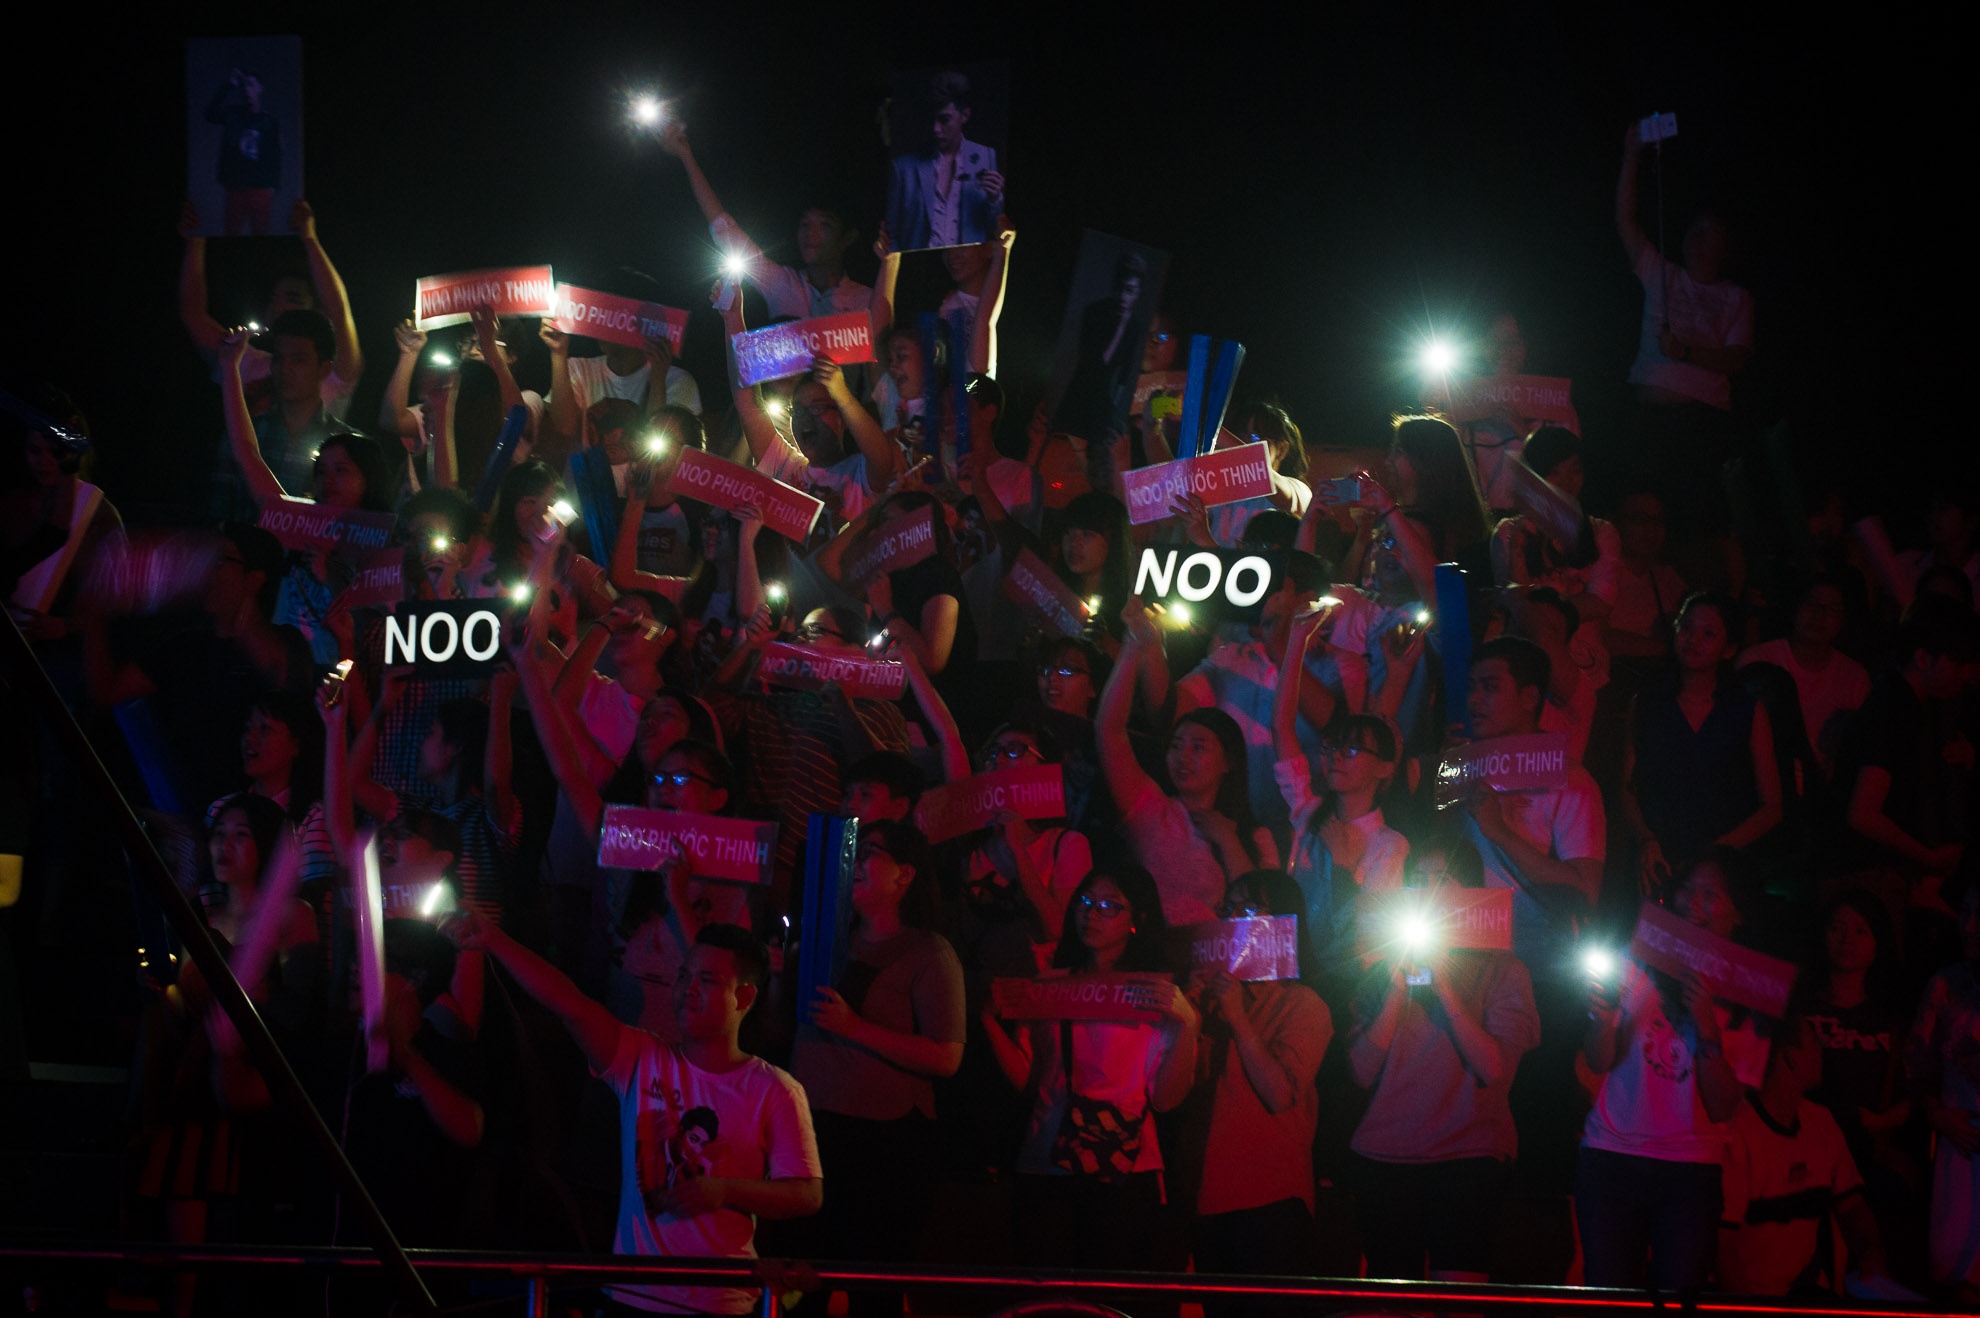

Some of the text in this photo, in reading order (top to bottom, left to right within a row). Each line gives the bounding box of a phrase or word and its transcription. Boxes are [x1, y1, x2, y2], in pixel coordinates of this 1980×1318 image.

[422, 289, 452, 316] NOO
[822, 326, 869, 352] THỊNH
[675, 461, 812, 530] NOO PHƯỚC THỊNH
[1130, 461, 1267, 507] NOO PHƯỚC THỊNH
[260, 509, 389, 549] NOO PHƯỚC THỊNH
[898, 520, 932, 551] THỊNH
[363, 565, 401, 592] THỊNH
[1134, 548, 1271, 607] NOO
[384, 610, 501, 665] NOO
[762, 656, 799, 676] NOO
[857, 664, 905, 689] THỊNH
[1515, 750, 1563, 776] THỊNH
[1008, 781, 1061, 807] THỊNH
[603, 824, 643, 850] NOO
[714, 836, 769, 865] THỊNH
